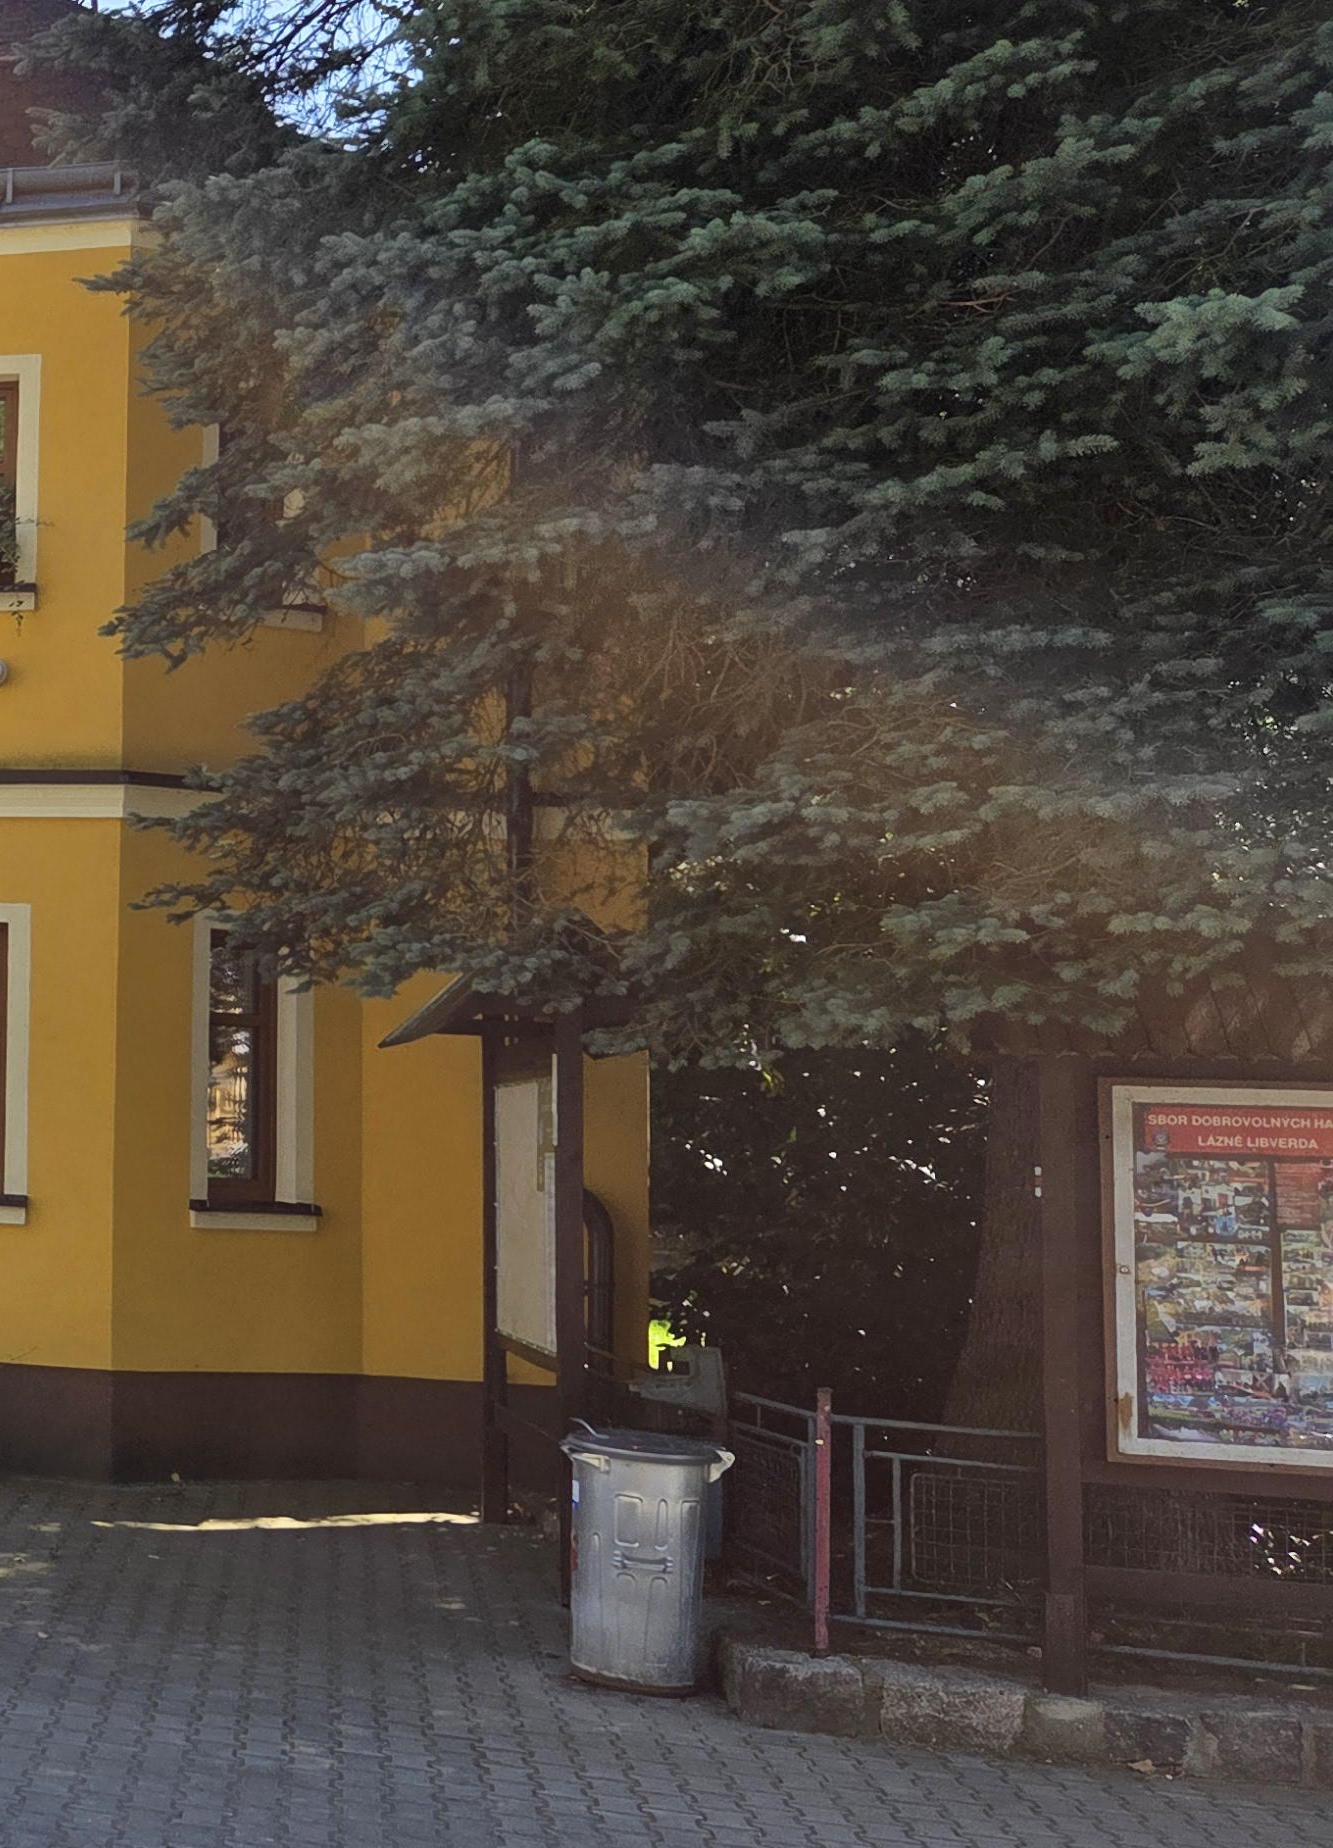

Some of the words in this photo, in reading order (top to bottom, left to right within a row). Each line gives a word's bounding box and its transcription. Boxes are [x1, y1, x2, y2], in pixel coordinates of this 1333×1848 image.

[1148, 1115, 1187, 1126] SBOR
[1192, 1114, 1311, 1129] DOBROVOLNÝCH
[1198, 1134, 1243, 1148] LÁZNĚ
[1247, 1137, 1318, 1149] LIBVERDA
